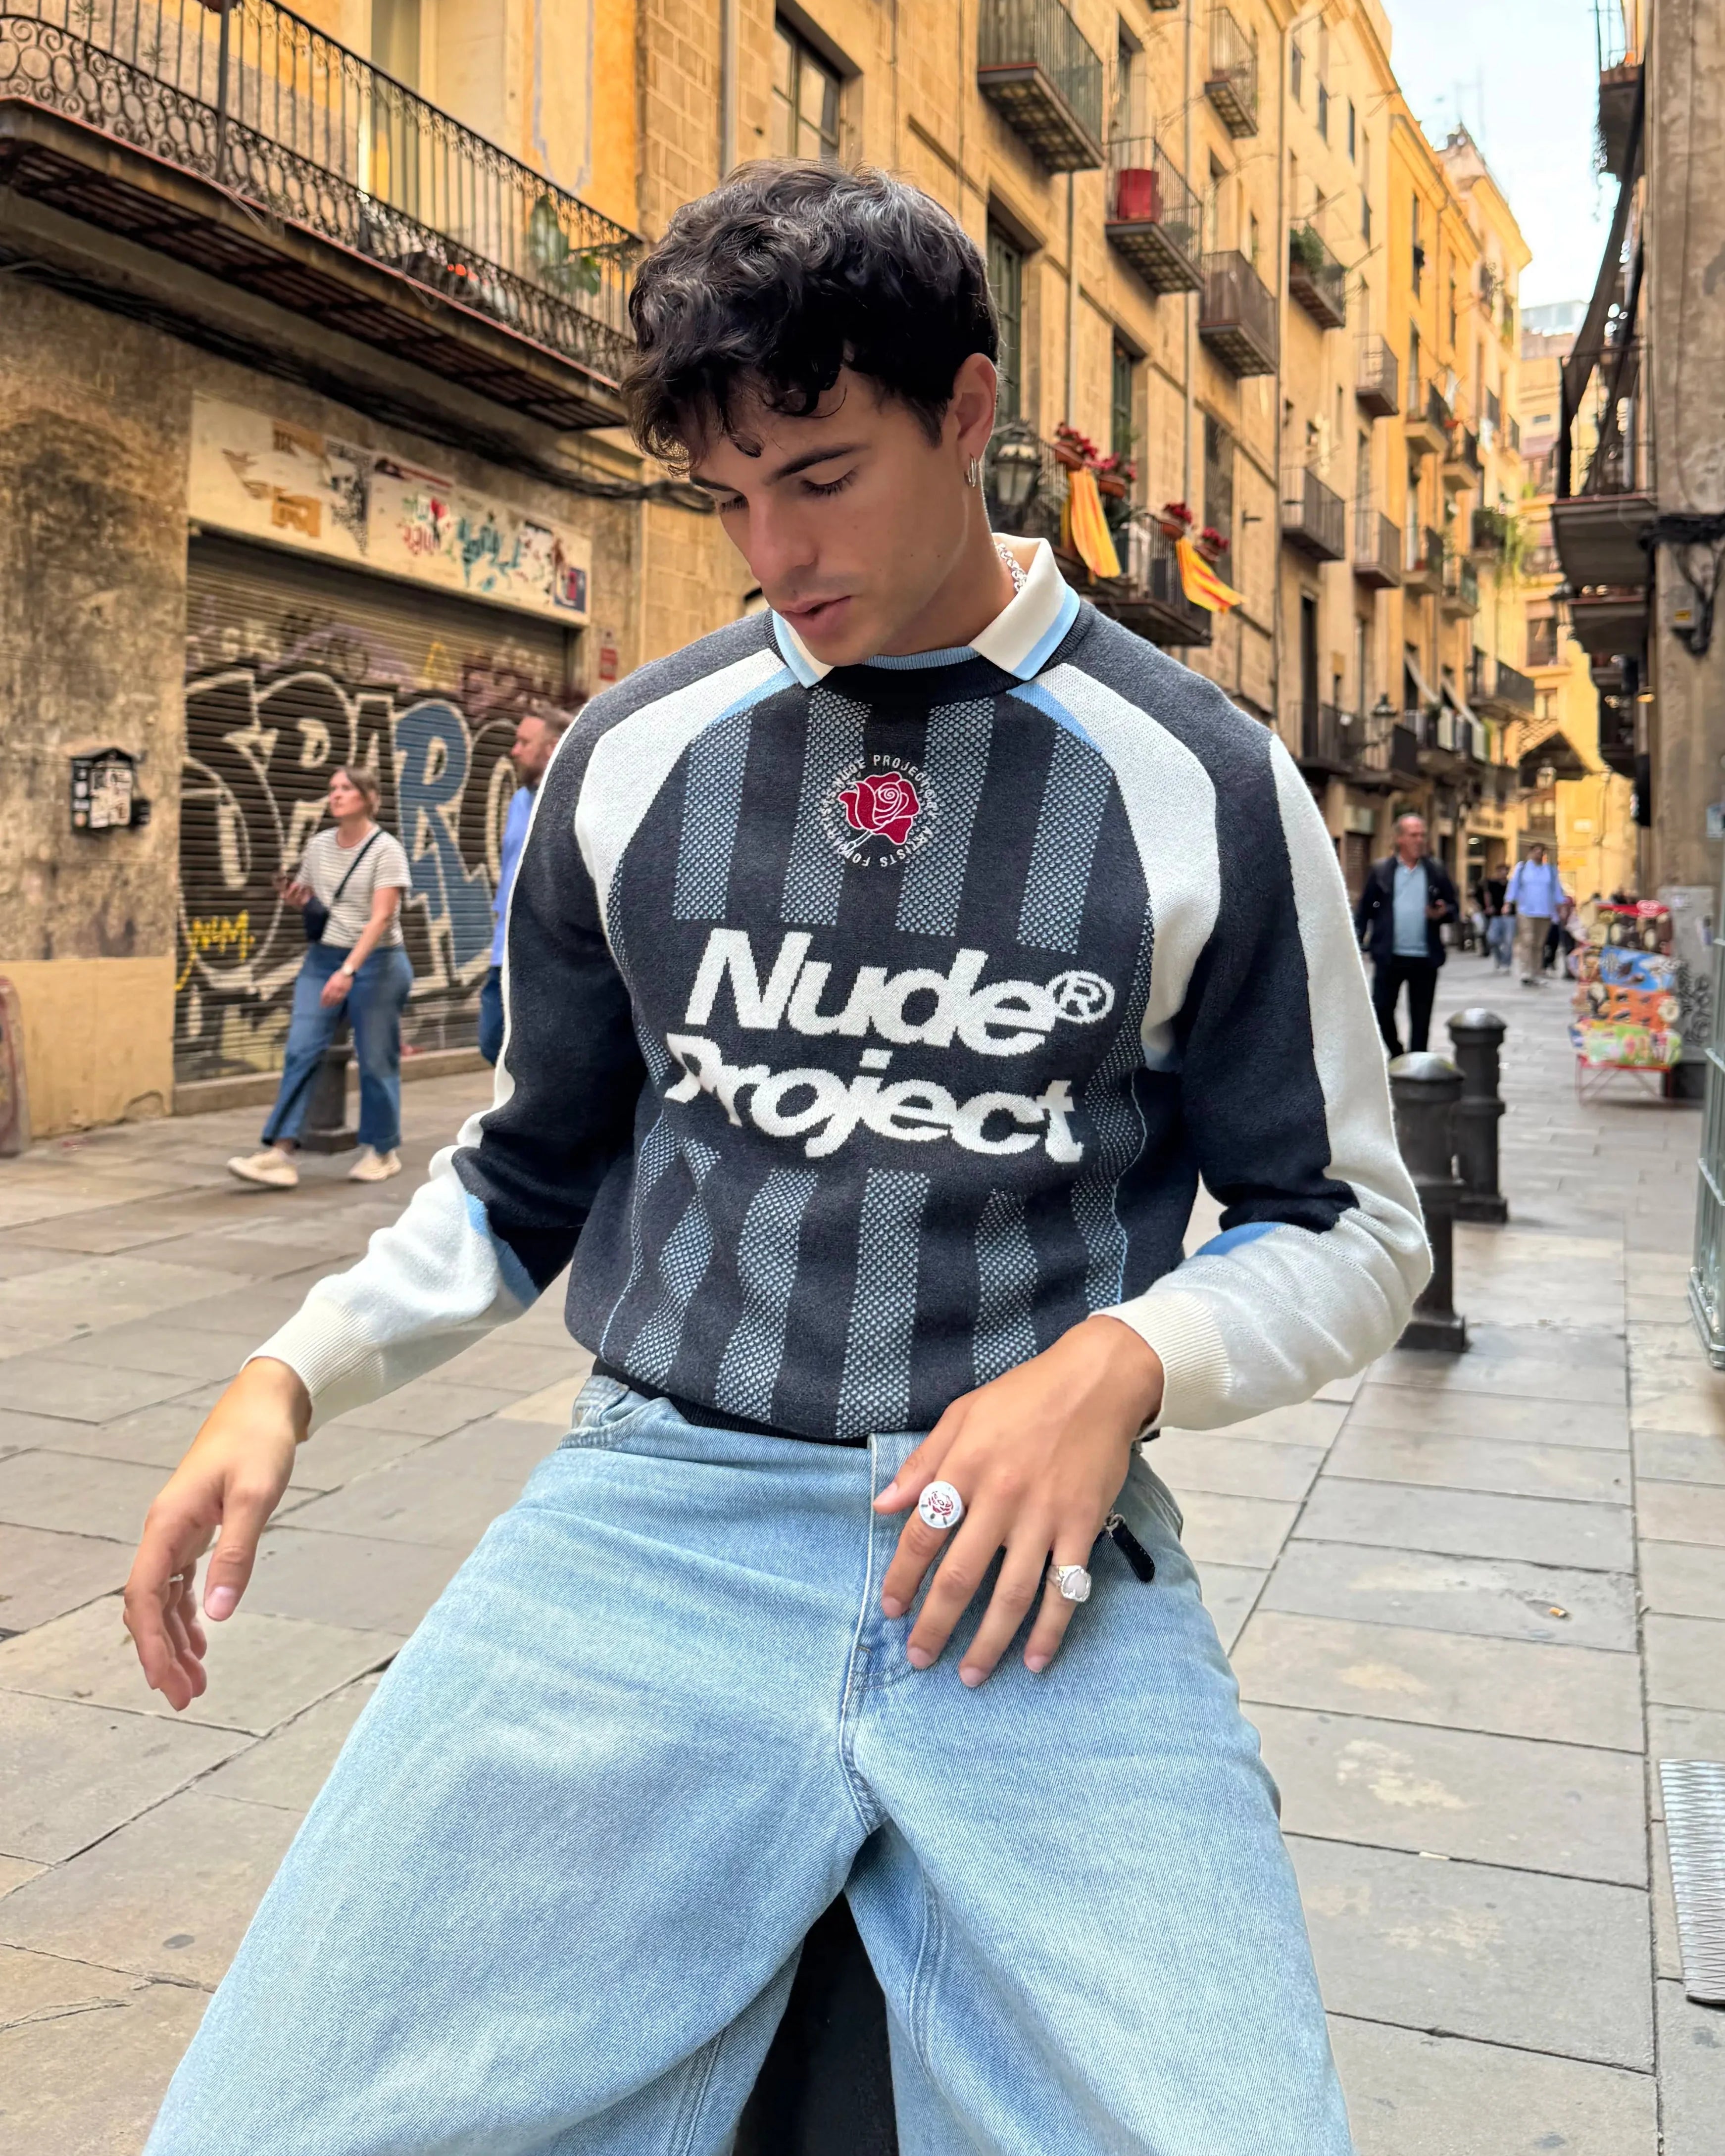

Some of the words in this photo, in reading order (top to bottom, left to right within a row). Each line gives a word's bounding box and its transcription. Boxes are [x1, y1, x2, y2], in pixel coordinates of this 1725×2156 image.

[834, 758, 866, 788] NUDE
[879, 825, 934, 868] ARTISTS
[664, 1033, 1084, 1163] Project
